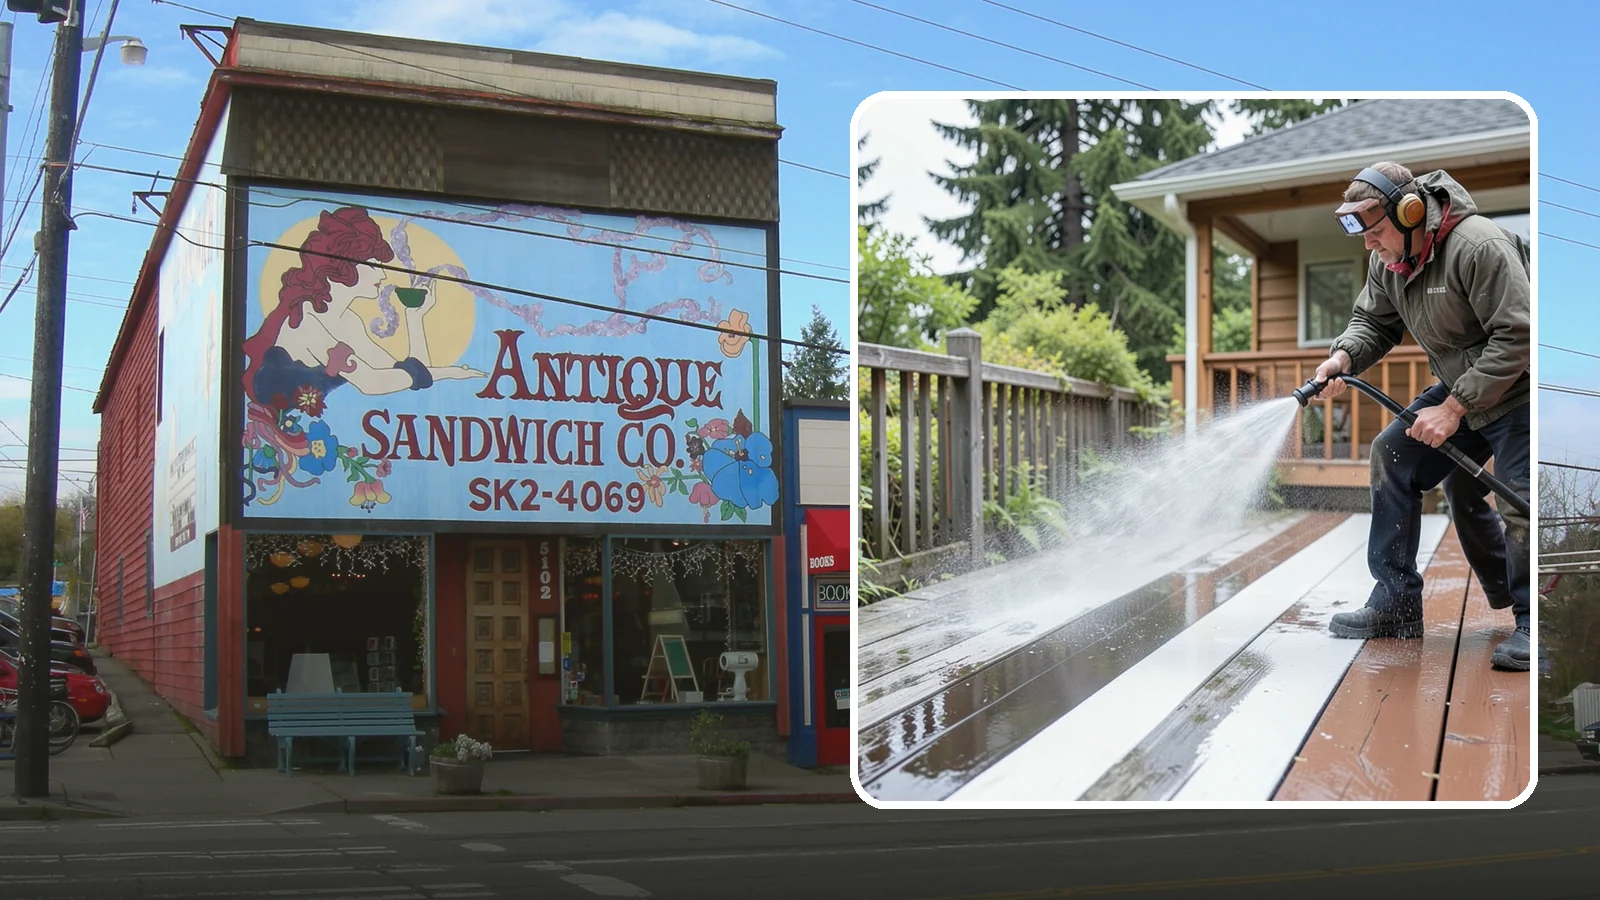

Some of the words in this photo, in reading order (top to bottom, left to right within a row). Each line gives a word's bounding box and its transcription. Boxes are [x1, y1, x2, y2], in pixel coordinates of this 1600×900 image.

[476, 329, 723, 420] ANTIQUE
[361, 408, 604, 467] SANDWICH
[616, 422, 685, 469] CO.
[468, 477, 645, 513] SK2-4069
[540, 541, 552, 600] 5102
[809, 555, 835, 569] BOOKS
